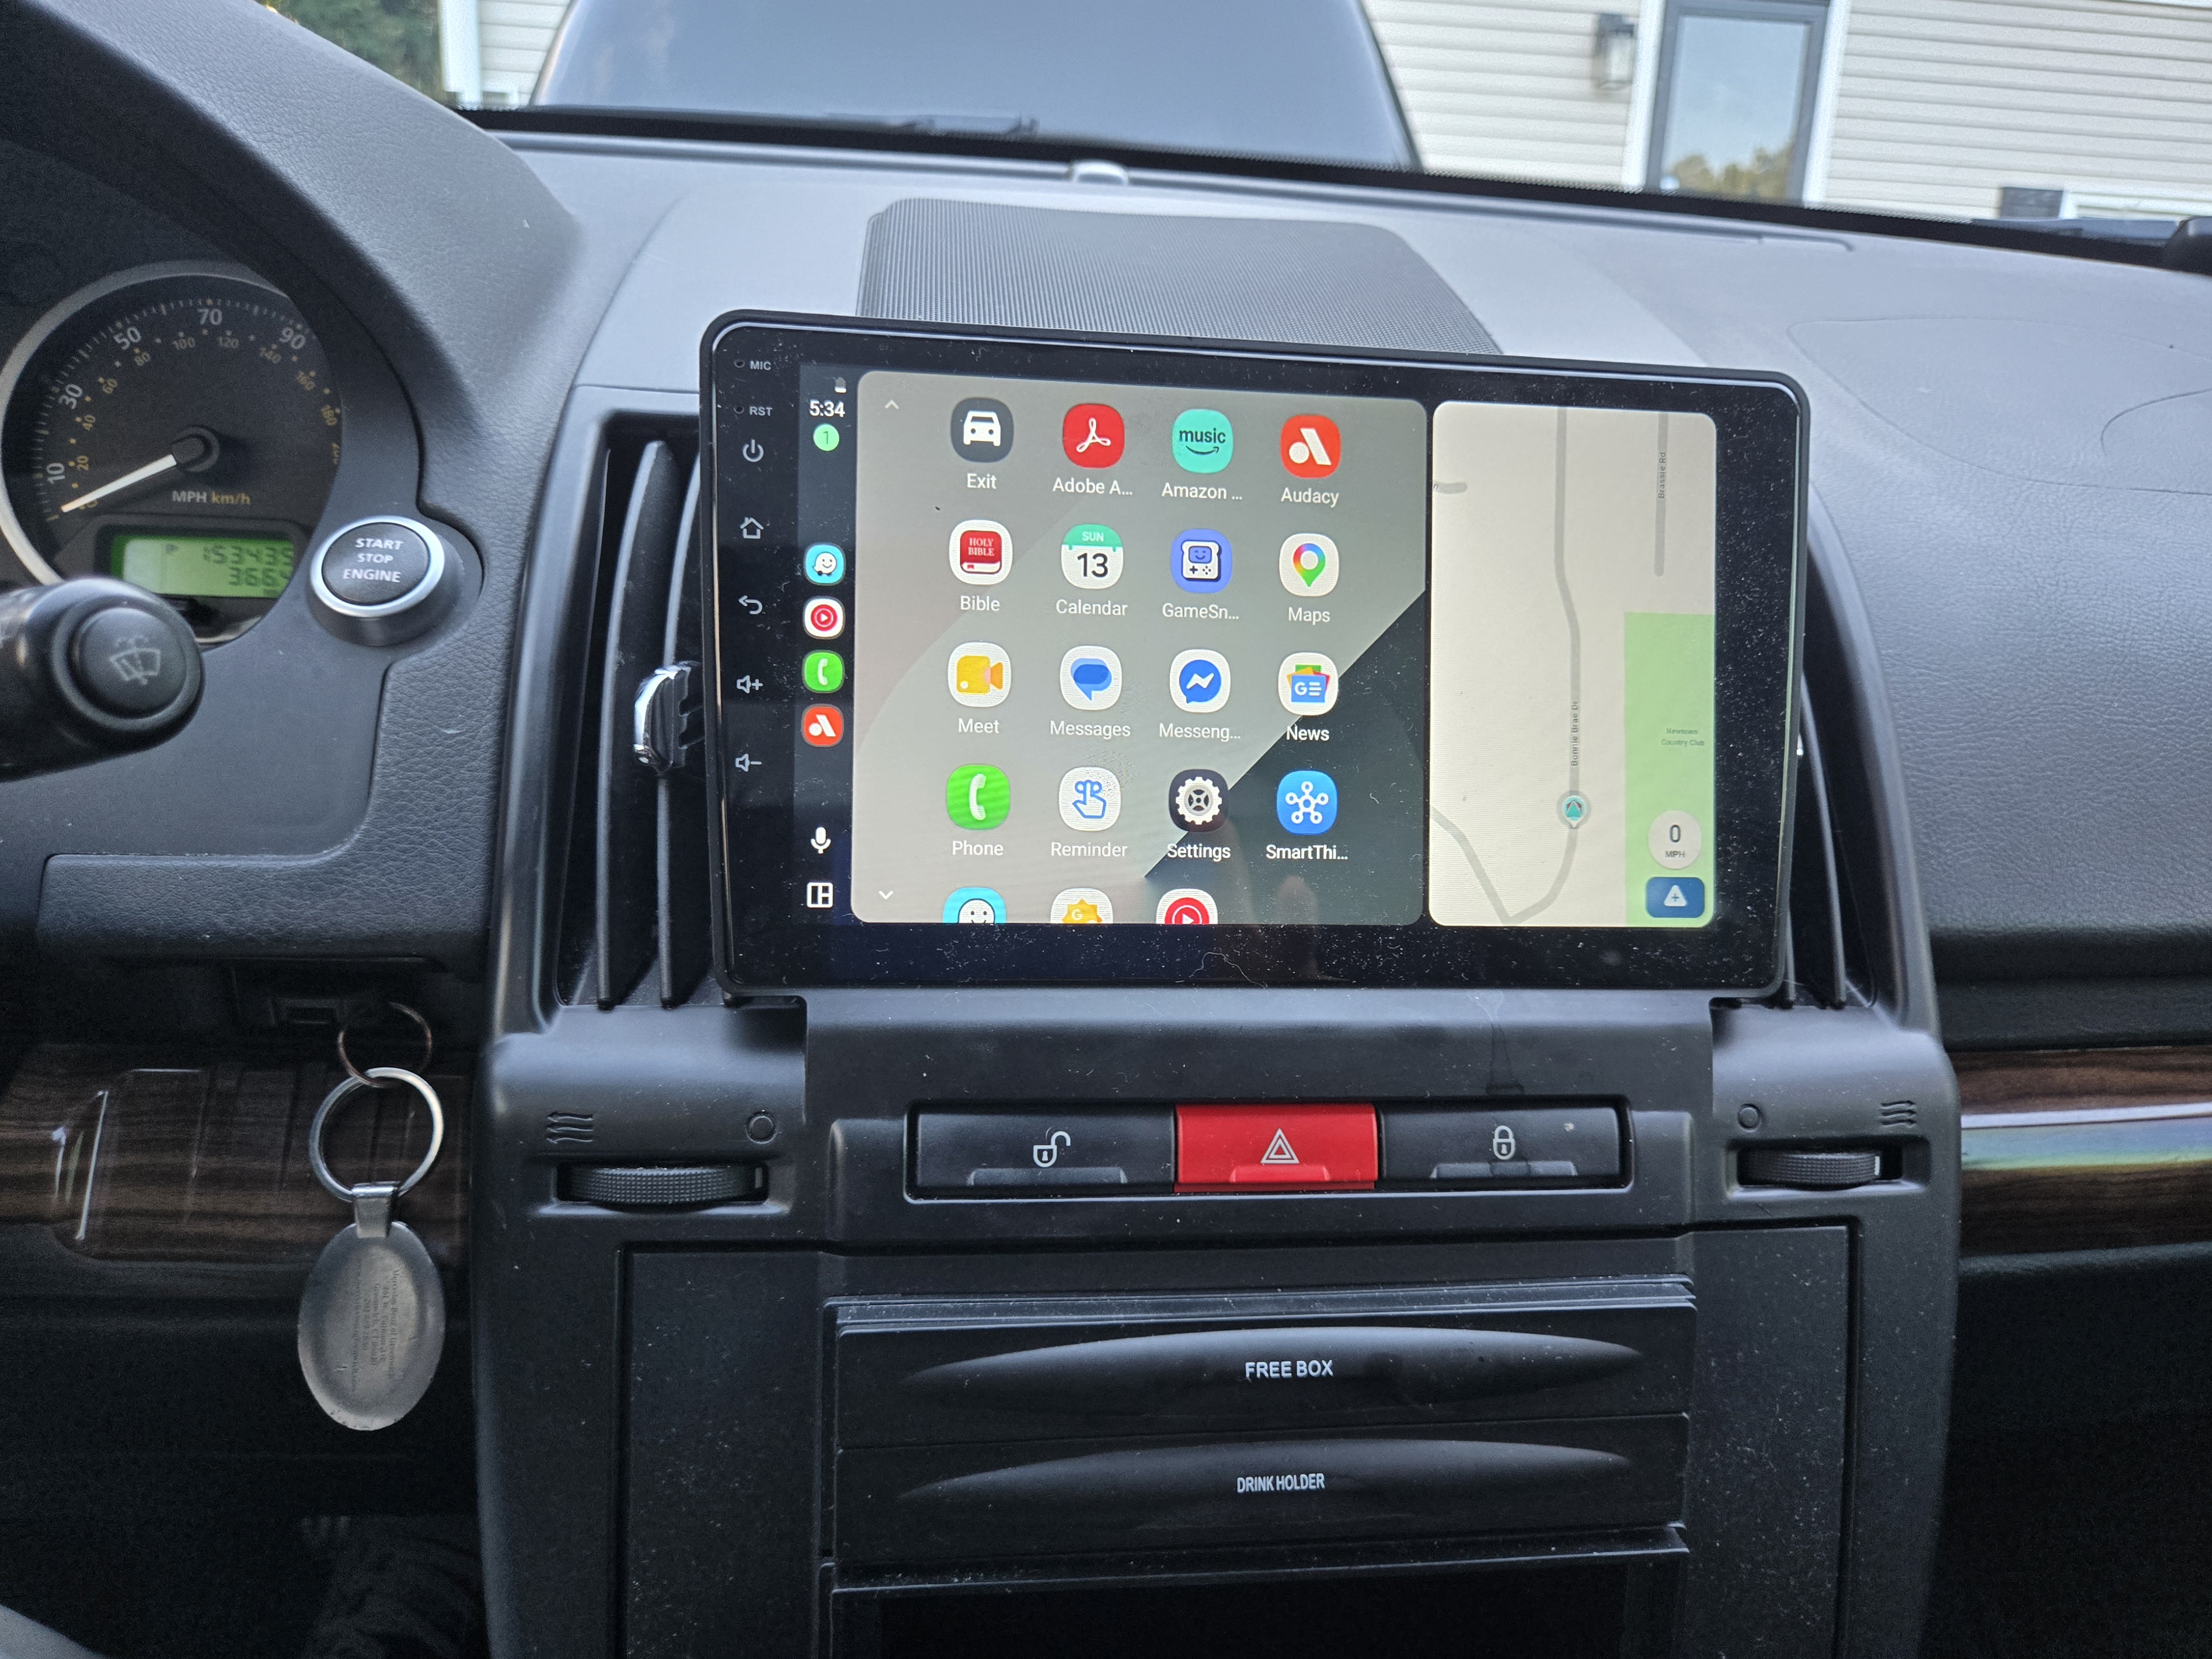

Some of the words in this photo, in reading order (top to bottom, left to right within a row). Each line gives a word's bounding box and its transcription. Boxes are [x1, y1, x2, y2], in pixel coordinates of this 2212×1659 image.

[197, 308, 222, 326] 70
[113, 326, 142, 350] 50
[172, 336, 195, 350] 100
[279, 326, 306, 350] 90
[749, 360, 772, 372] MIC
[102, 378, 118, 394] 60
[58, 383, 83, 410] 30
[749, 406, 773, 417] RST
[809, 400, 846, 418] 5:34
[82, 414, 96, 431] 40
[822, 430, 830, 445] 1
[1179, 427, 1227, 445] music
[76, 455, 90, 471] 20
[1659, 452, 1666, 463] Rd
[46, 462, 66, 485] 10
[967, 473, 997, 490] Exit
[1052, 478, 1105, 495] Adobe
[1161, 482, 1227, 500] Amazon
[172, 491, 207, 504] MPH
[211, 489, 251, 506] km/h
[1280, 487, 1339, 508] Audacy
[355, 538, 404, 550] START
[969, 538, 994, 547] HOLY
[1082, 530, 1105, 542] SUN
[357, 553, 394, 564] STOP
[968, 546, 995, 557] BIBLE
[1076, 551, 1109, 578] 13
[343, 568, 402, 583] ENGINE
[960, 596, 1000, 612] Bible
[1055, 599, 1128, 617] Calendar
[1287, 607, 1331, 625] Maps
[1572, 700, 1579, 710] Dr
[957, 718, 1000, 734] Meet
[1050, 721, 1131, 739] Messages
[1286, 726, 1330, 741] News
[1661, 739, 1688, 747] Country
[1670, 824, 1681, 843] 0
[952, 840, 1004, 856] Phone
[1051, 842, 1128, 857] Reminder
[1167, 843, 1232, 862] Settings
[1665, 850, 1686, 859] MPH
[1245, 1360, 1292, 1379] FREE
[1296, 1359, 1334, 1378] BOX
[1237, 1475, 1275, 1493] DRINK
[1276, 1473, 1326, 1491] HOLDER
